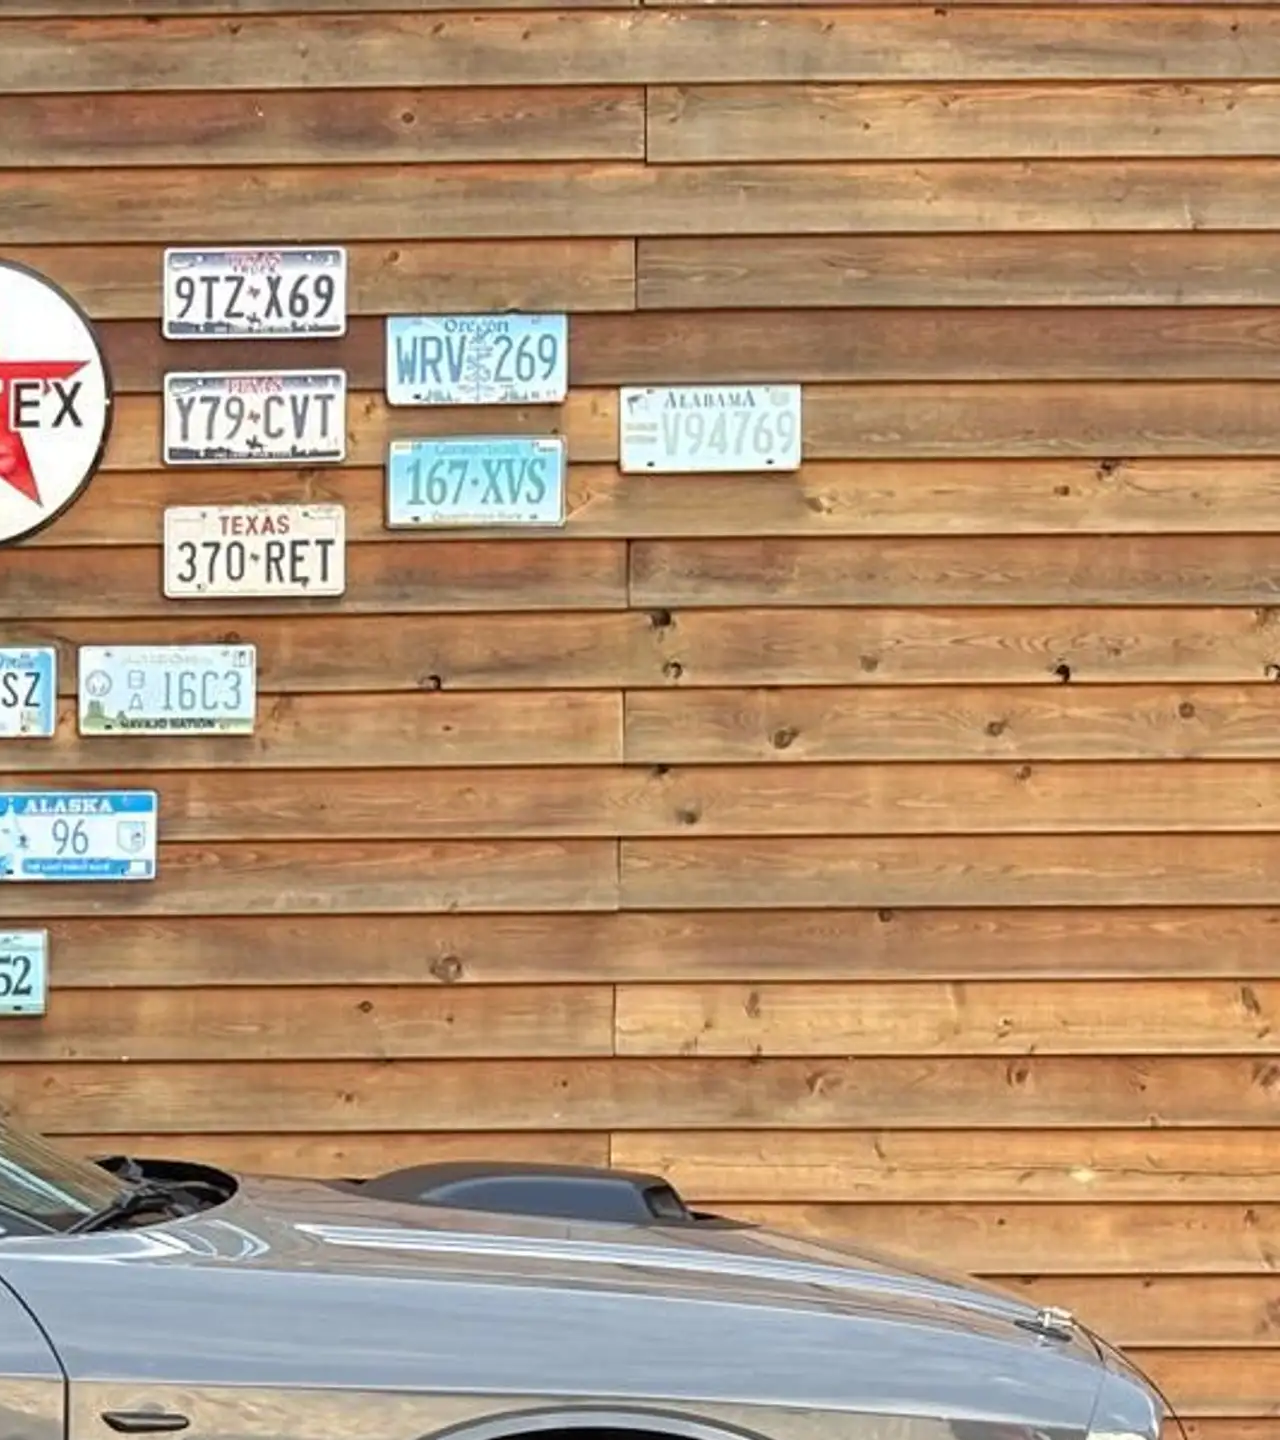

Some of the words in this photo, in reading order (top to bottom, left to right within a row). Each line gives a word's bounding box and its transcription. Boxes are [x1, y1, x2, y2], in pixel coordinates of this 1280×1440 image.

[664, 390, 756, 409] ALABAMA
[218, 515, 290, 536] TEXAS
[23, 798, 115, 813] ALASKA
[52, 818, 88, 855] 96
